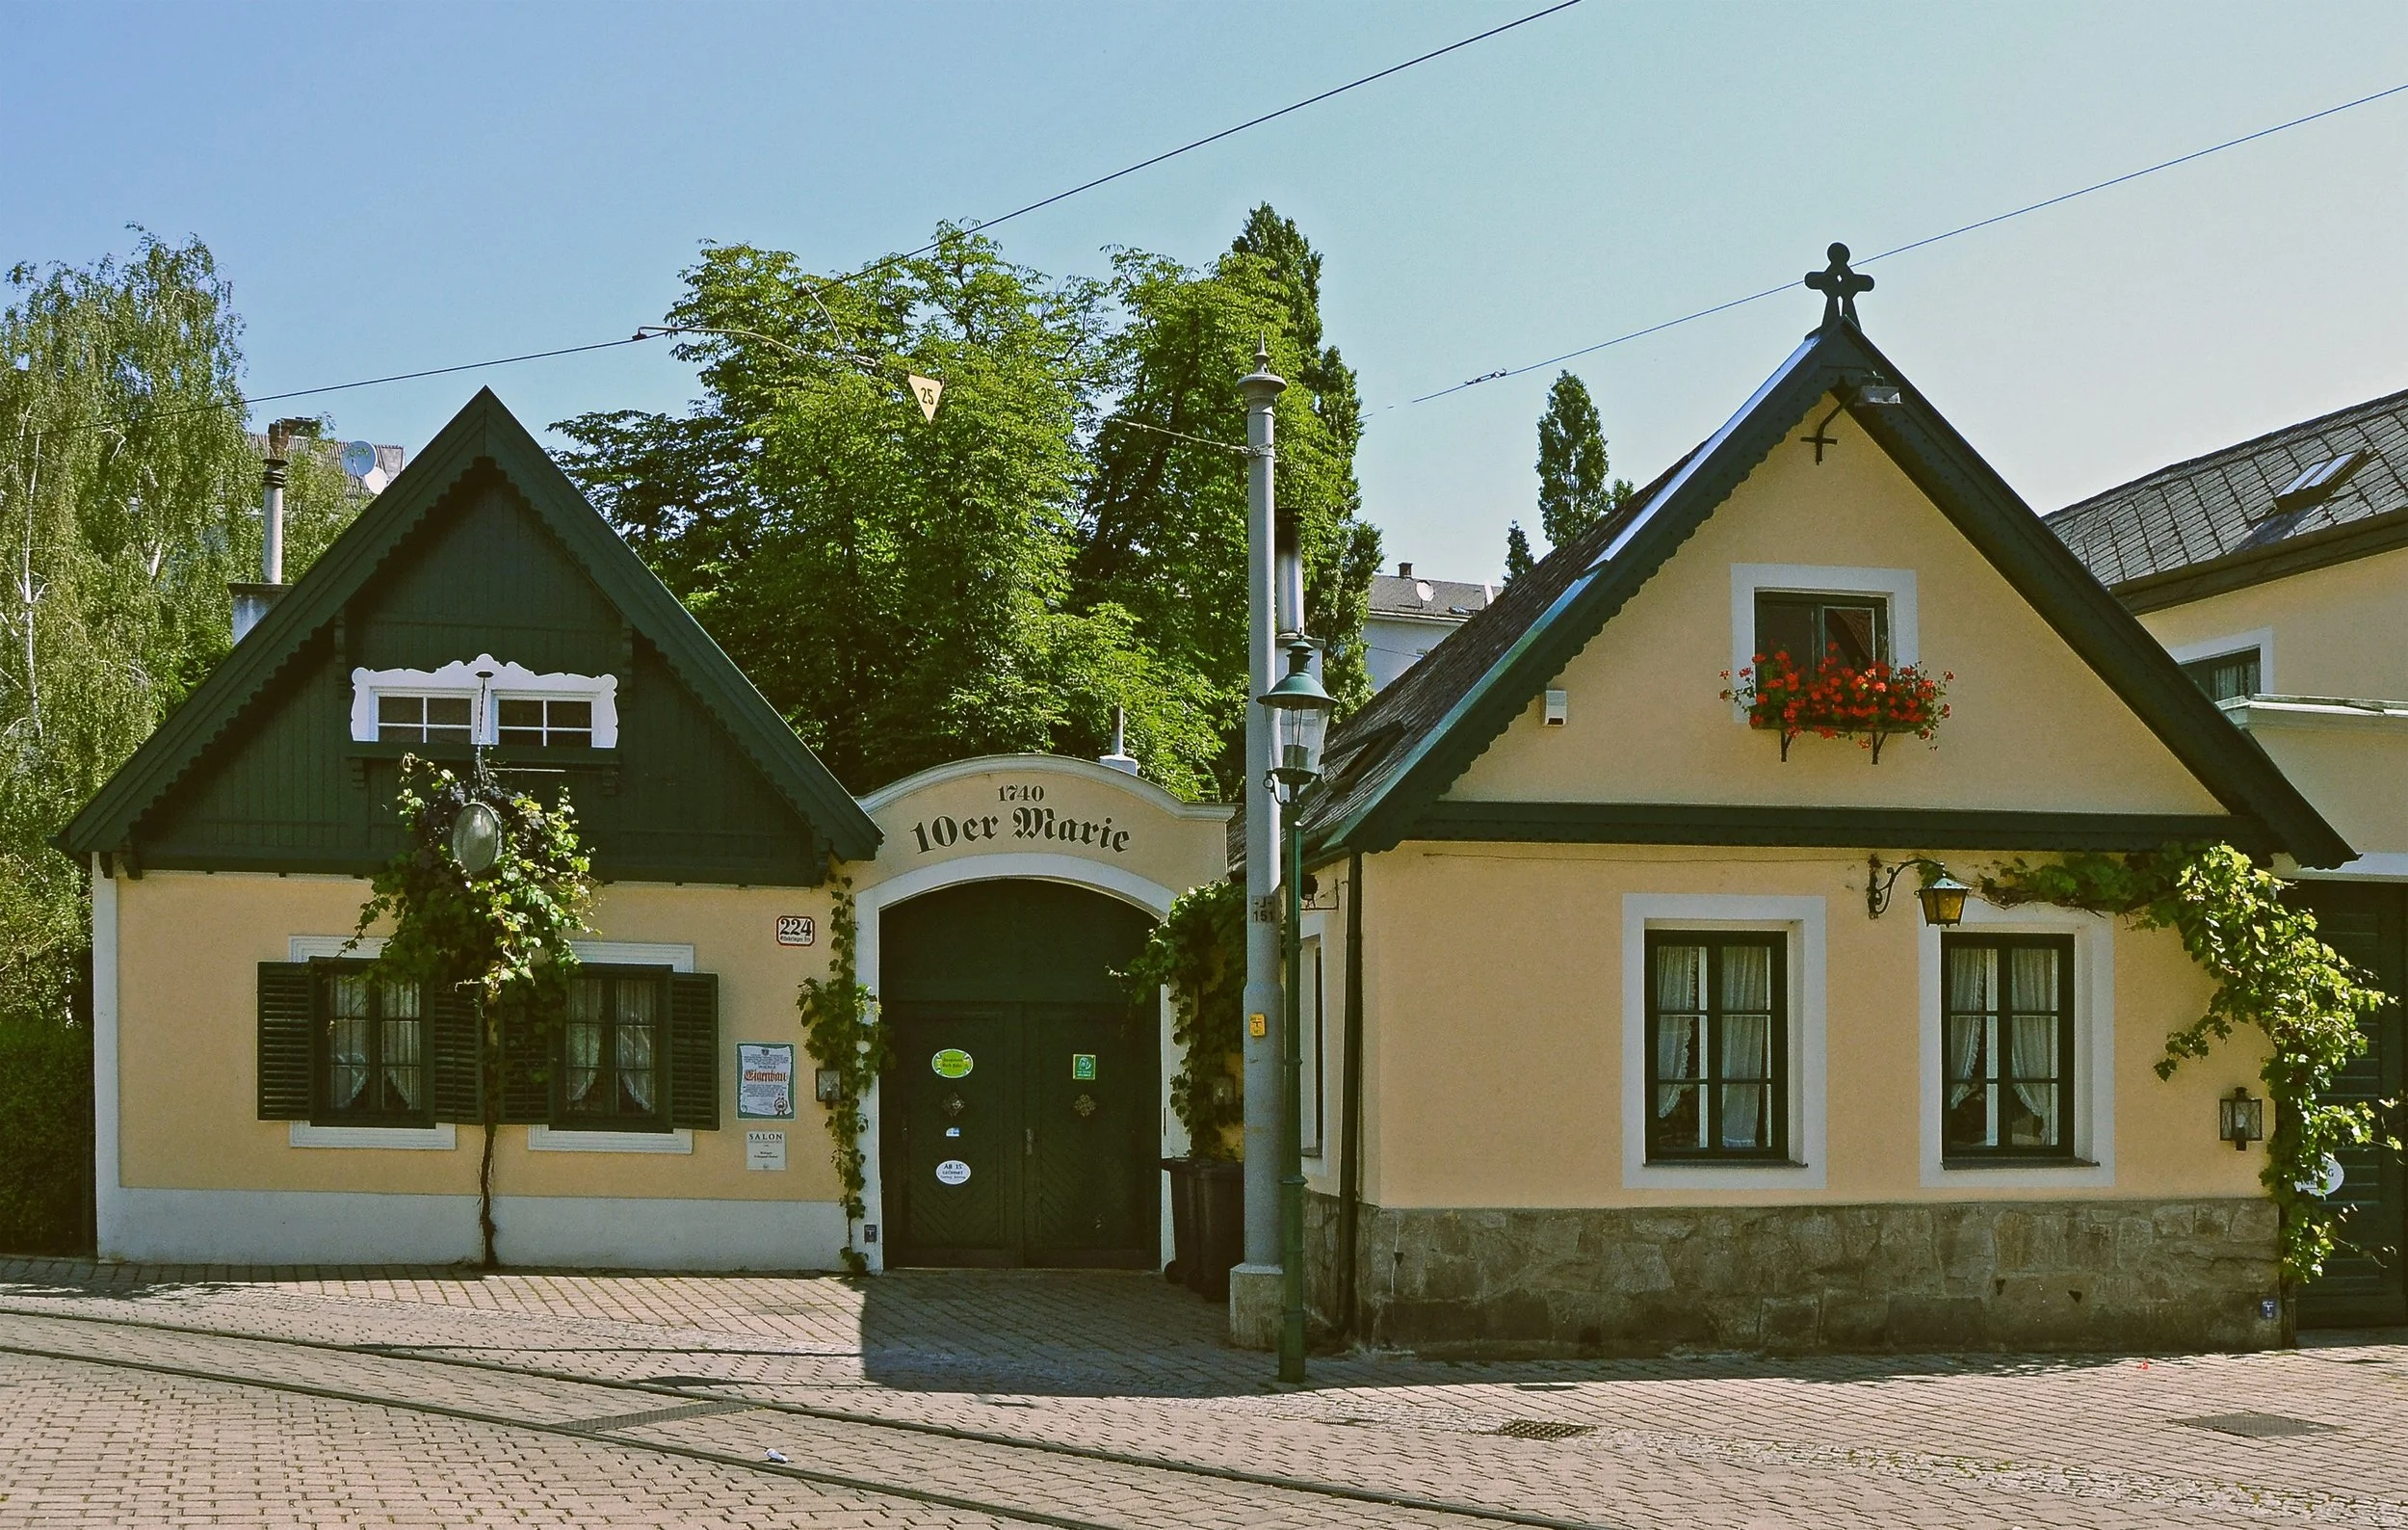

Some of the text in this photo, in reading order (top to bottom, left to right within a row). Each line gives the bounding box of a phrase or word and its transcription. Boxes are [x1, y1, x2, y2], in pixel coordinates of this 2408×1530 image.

[920, 386, 934, 406] 25
[998, 785, 1045, 802] 1740
[910, 806, 1131, 855] 10er Marie
[1253, 910, 1273, 922] 151
[780, 918, 812, 936] 224
